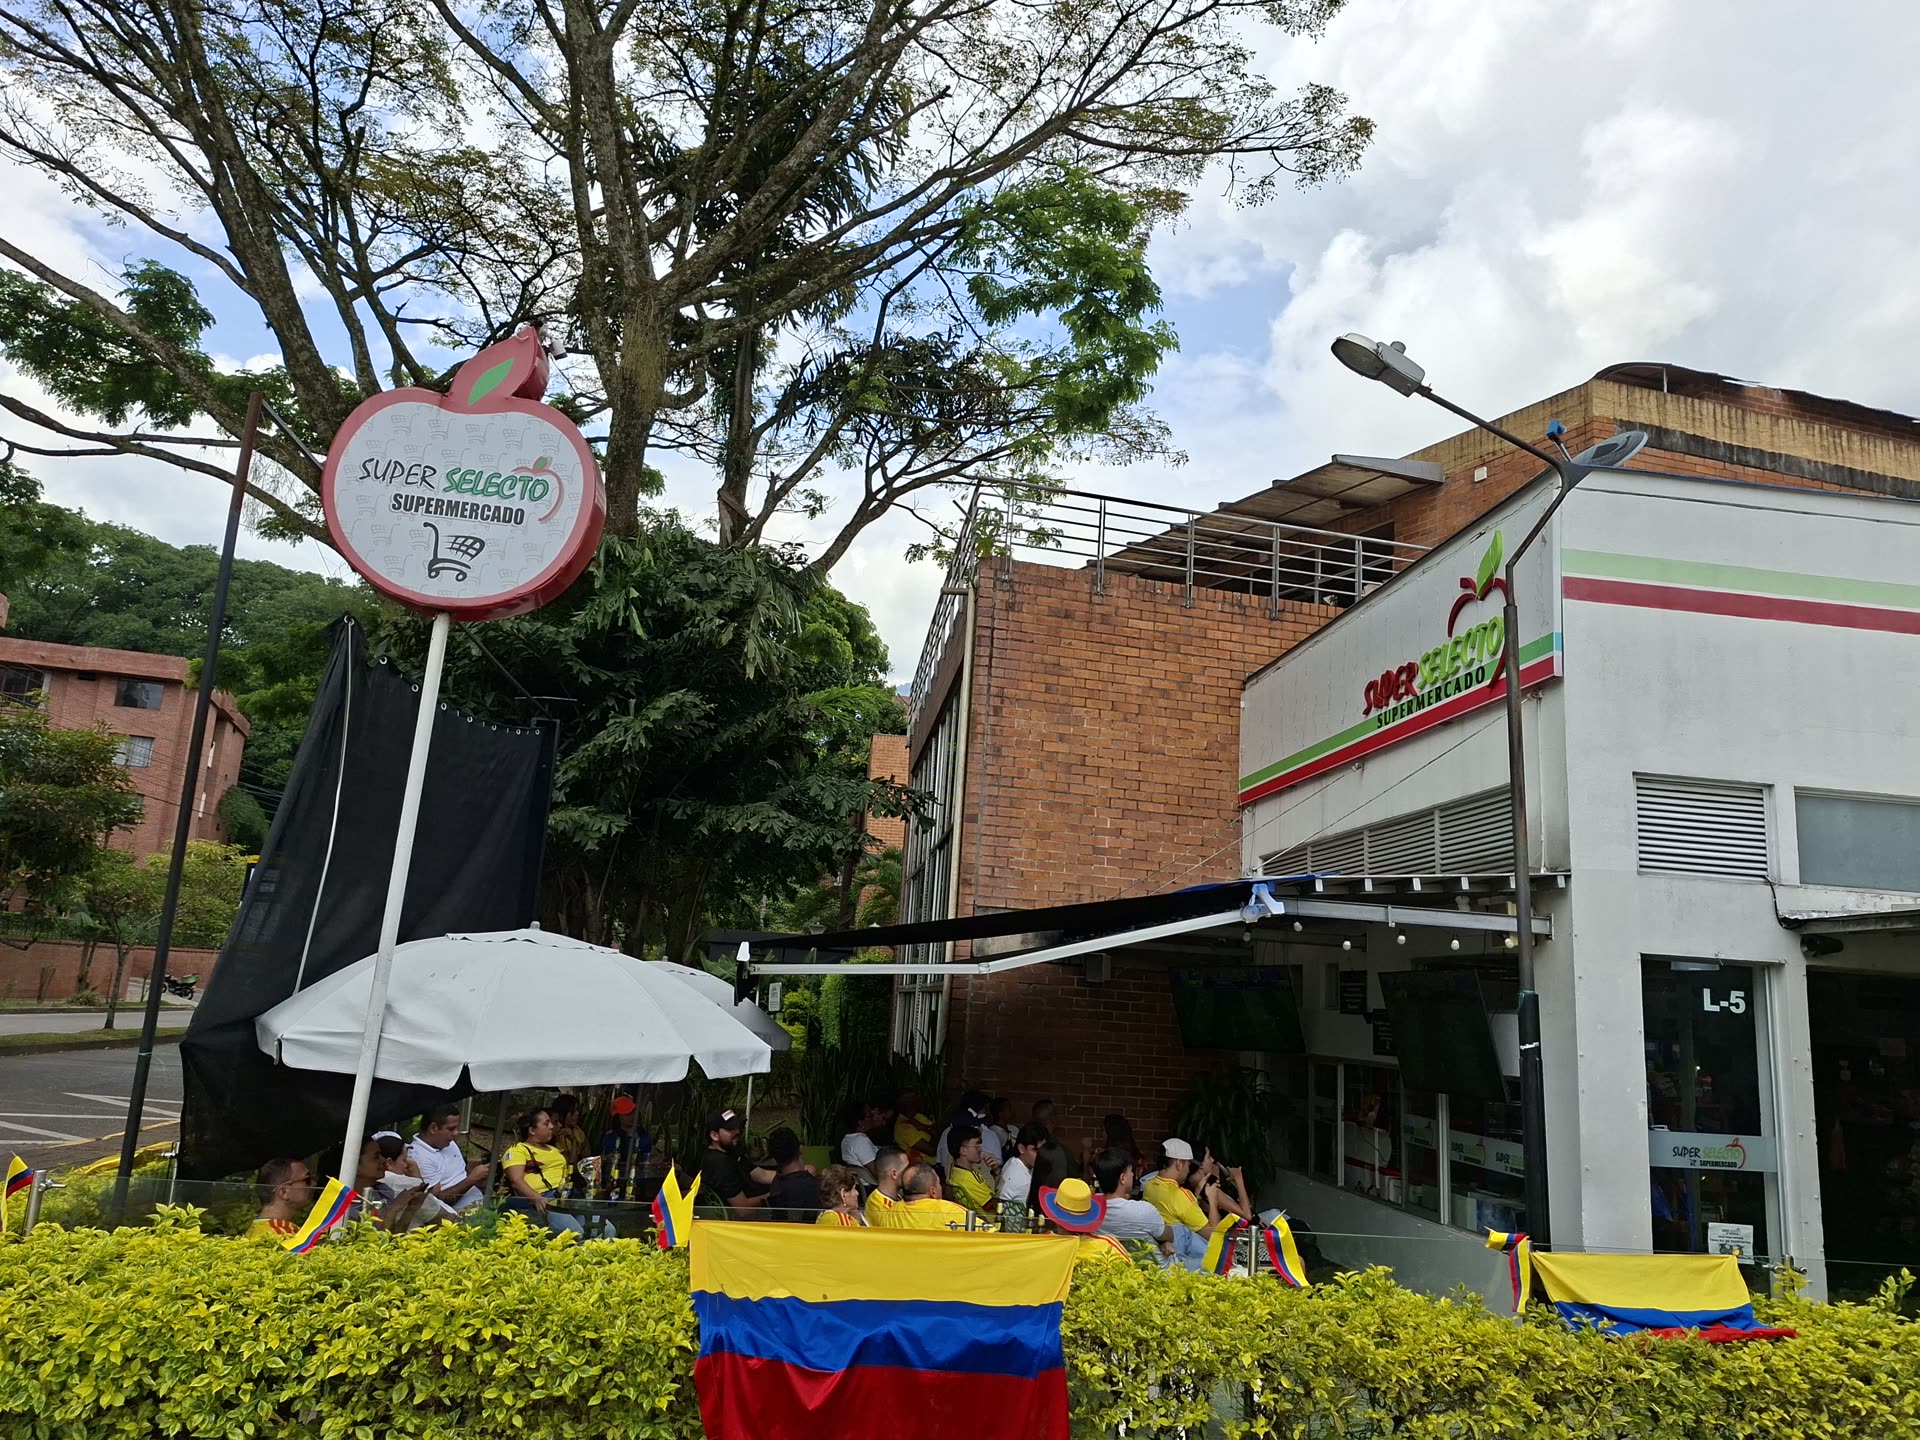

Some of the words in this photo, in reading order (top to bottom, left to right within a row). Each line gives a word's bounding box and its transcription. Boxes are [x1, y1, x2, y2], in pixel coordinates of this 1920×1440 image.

[358, 457, 437, 490] SUPER
[442, 467, 550, 502] SELECTO
[391, 493, 526, 526] SUPERMERCADO
[1362, 661, 1419, 716] SUPER
[1417, 616, 1505, 690] SELECTO
[1377, 665, 1486, 729] SUPERMERCADO
[1703, 988, 1746, 1014] L-5
[1672, 1145, 1701, 1159] SUPER
